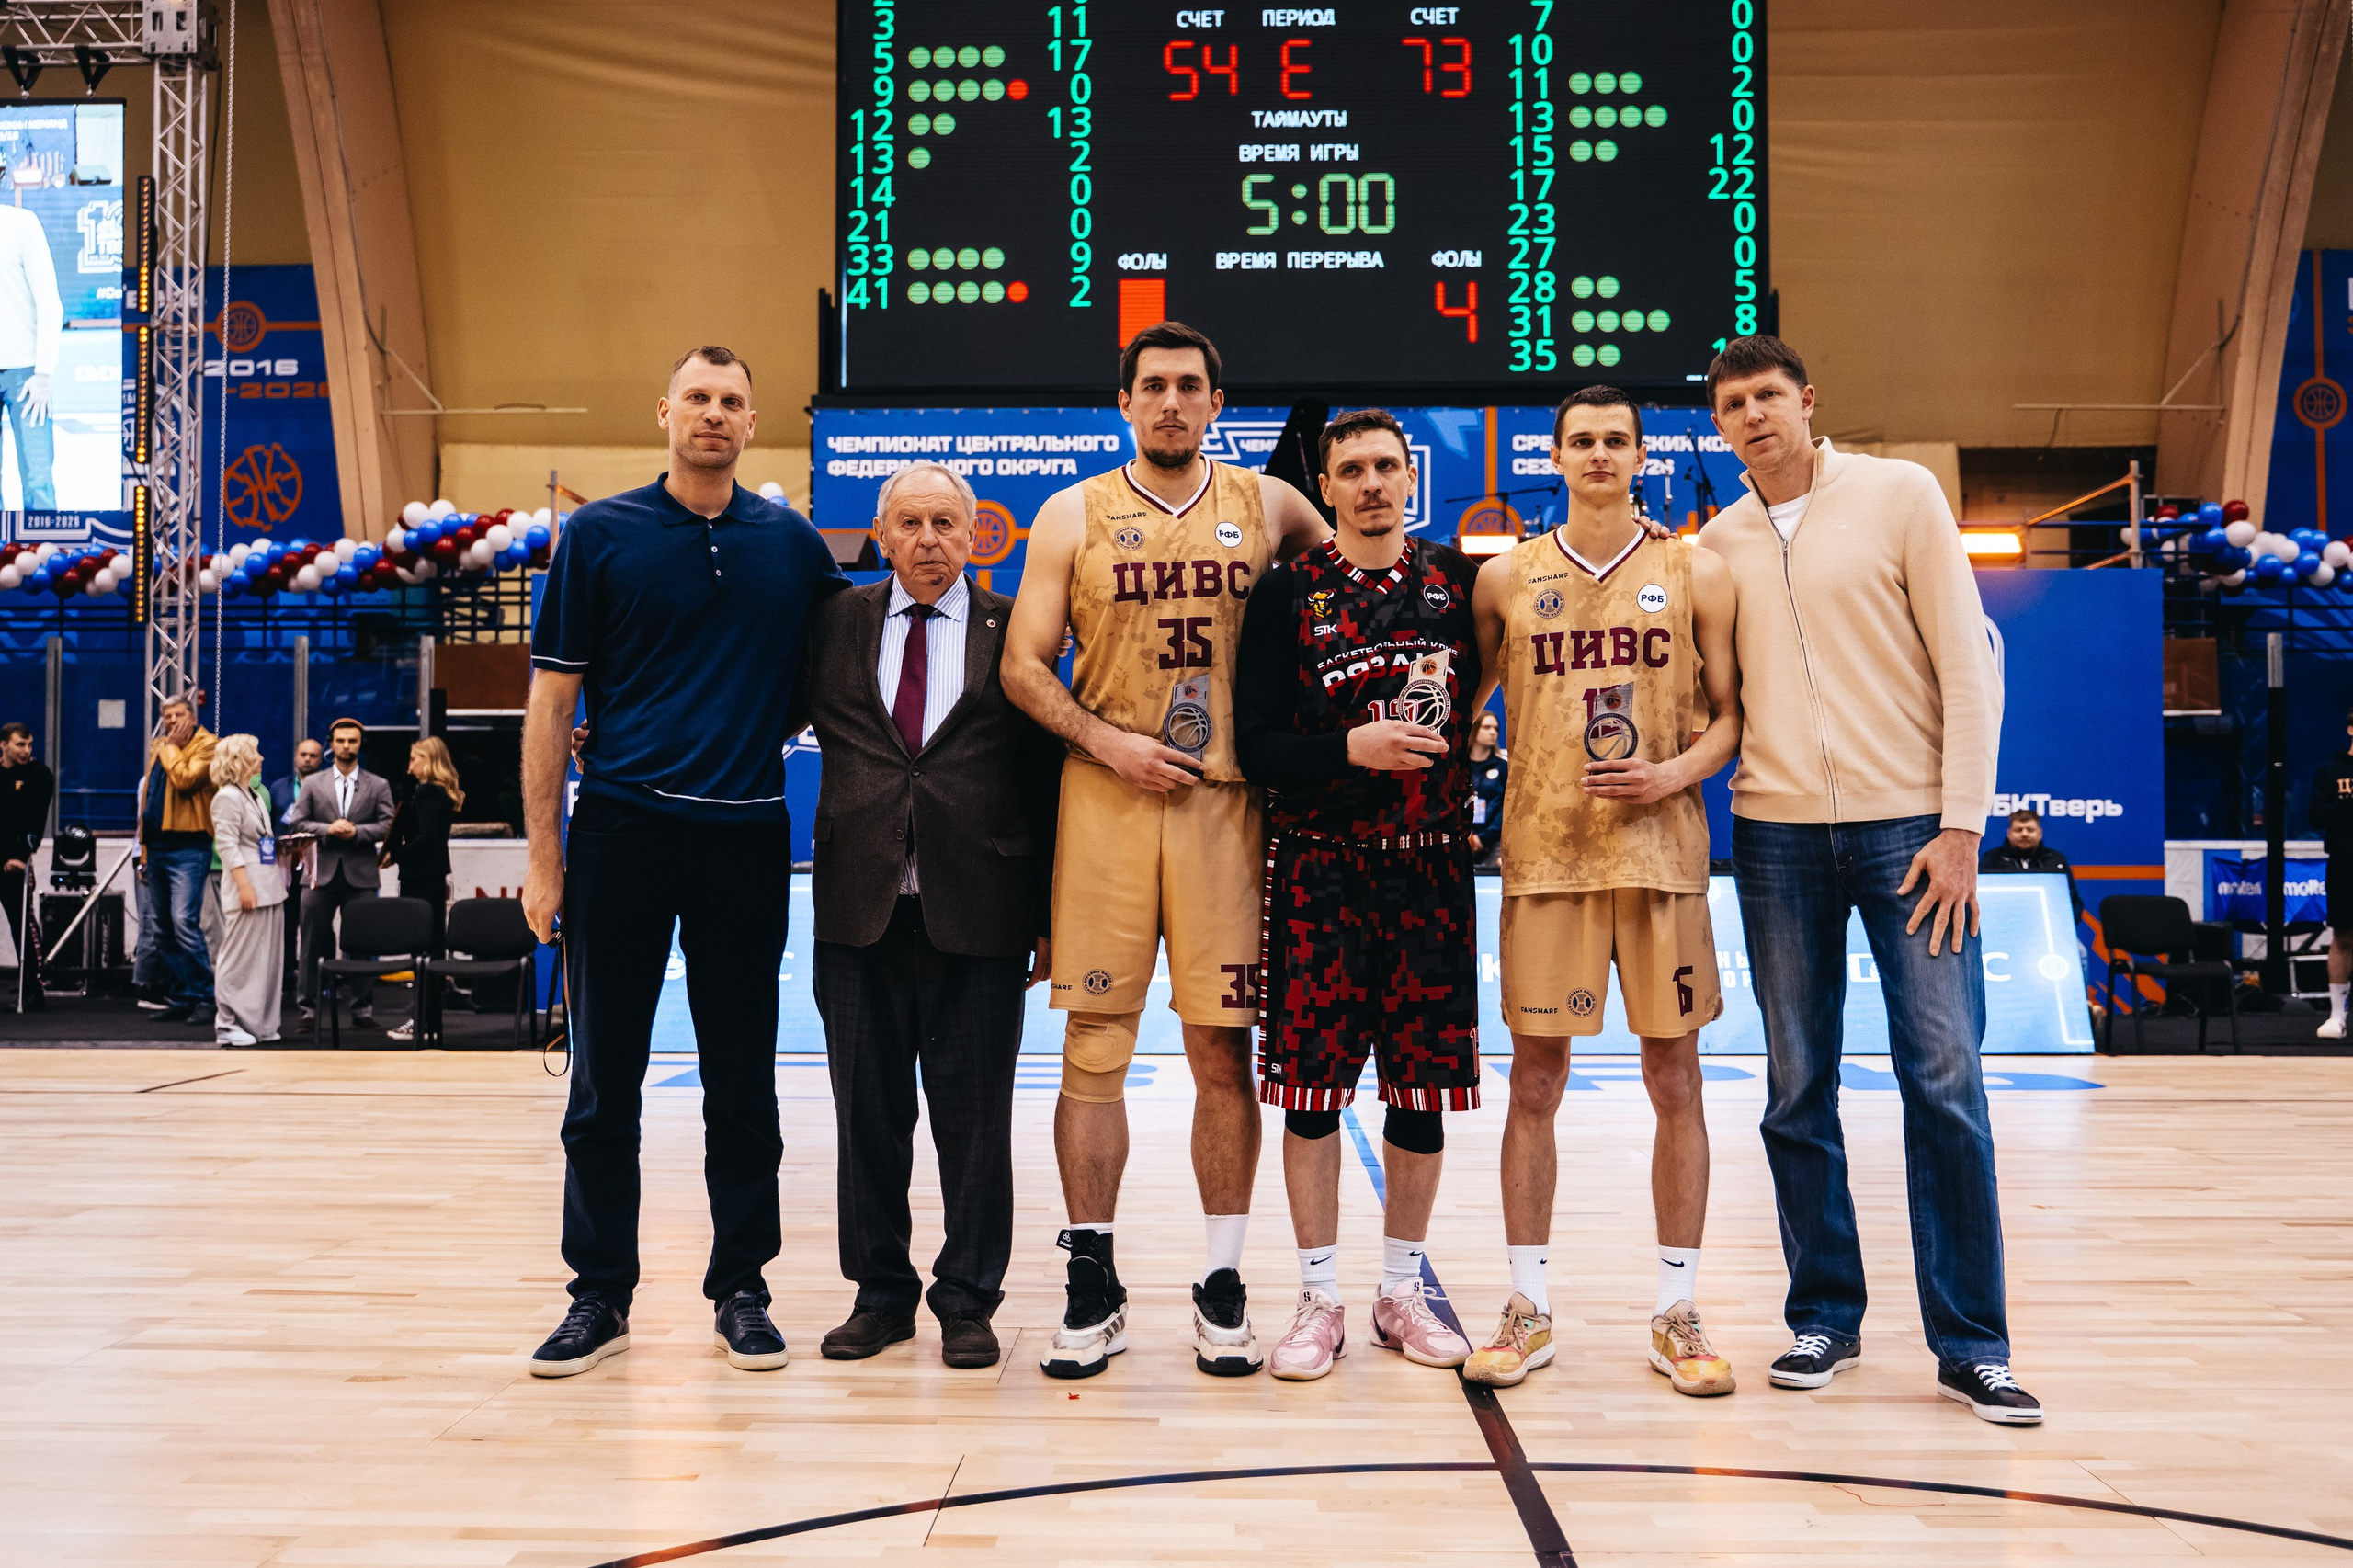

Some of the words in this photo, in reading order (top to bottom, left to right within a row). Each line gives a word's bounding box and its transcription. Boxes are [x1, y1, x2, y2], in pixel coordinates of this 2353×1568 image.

[873, 9, 894, 40] 3
[1048, 6, 1086, 37] 11
[1176, 10, 1223, 28] СЧЕТ
[1263, 9, 1335, 26] ПЕРИОД
[1411, 8, 1458, 25] СЧЕТ
[1531, 0, 1553, 31] 7
[1732, 0, 1753, 28] 0
[874, 42, 894, 74] 5
[1048, 40, 1092, 71] 17
[1509, 34, 1552, 65] 10
[1732, 31, 1753, 62] 0
[1165, 41, 1237, 100] 54
[1403, 38, 1471, 97] 73
[1509, 67, 1547, 99] 11
[1732, 65, 1754, 97] 2
[874, 75, 894, 107] 9
[1071, 73, 1091, 104] 0
[851, 109, 893, 141] 12
[1048, 107, 1091, 138] 13
[1251, 110, 1347, 128] ТАЙМАУТЫ
[1509, 101, 1553, 133] 13
[1733, 99, 1754, 131] 0
[851, 142, 893, 174] 13
[1070, 140, 1091, 171] 2
[1239, 144, 1299, 162] ВРЕМЯ
[1311, 144, 1358, 161] ИГРЫ
[1510, 135, 1554, 166] 15
[1710, 133, 1755, 165] 12
[851, 176, 896, 208] 14
[1071, 174, 1091, 205] 0
[1510, 169, 1555, 200] 17
[1708, 167, 1755, 199] 22
[1244, 173, 1395, 234] 5:00
[1508, 203, 1555, 235] 23
[1734, 201, 1756, 233] 0
[847, 210, 888, 242] 21
[1071, 208, 1091, 239] 0
[847, 244, 893, 276] 33
[1071, 242, 1091, 273] 9
[1118, 253, 1166, 270] ФОЛЫ
[1216, 252, 1276, 269] ВРЕМЯ
[1288, 252, 1383, 268] ПЕРЕРЫВА
[1432, 250, 1481, 267] ФОЛЫ
[1508, 237, 1556, 269] 27
[1734, 235, 1756, 267] 0
[844, 277, 887, 311] 41
[1070, 275, 1091, 307] 2
[1508, 271, 1555, 303] 28
[1735, 269, 1756, 301] 5
[1436, 282, 1477, 342] 4
[1509, 305, 1550, 337] 31
[1735, 303, 1756, 335] 8
[204, 358, 299, 377] 2016
[1509, 339, 1556, 371] 35
[828, 436, 953, 453] ЧЕМПИОНАТ
[956, 435, 1120, 454] ЦЕНТРАЛЬНОГО
[996, 458, 1078, 476] ОКРУГА
[1219, 529, 1240, 539] РФБ
[1113, 560, 1251, 605] ЦИВС
[1427, 592, 1446, 602] РФБ
[1641, 594, 1664, 603] РФБ
[1158, 617, 1212, 670] 35
[1314, 623, 1337, 636] STK
[1531, 626, 1671, 676] ЦИВС
